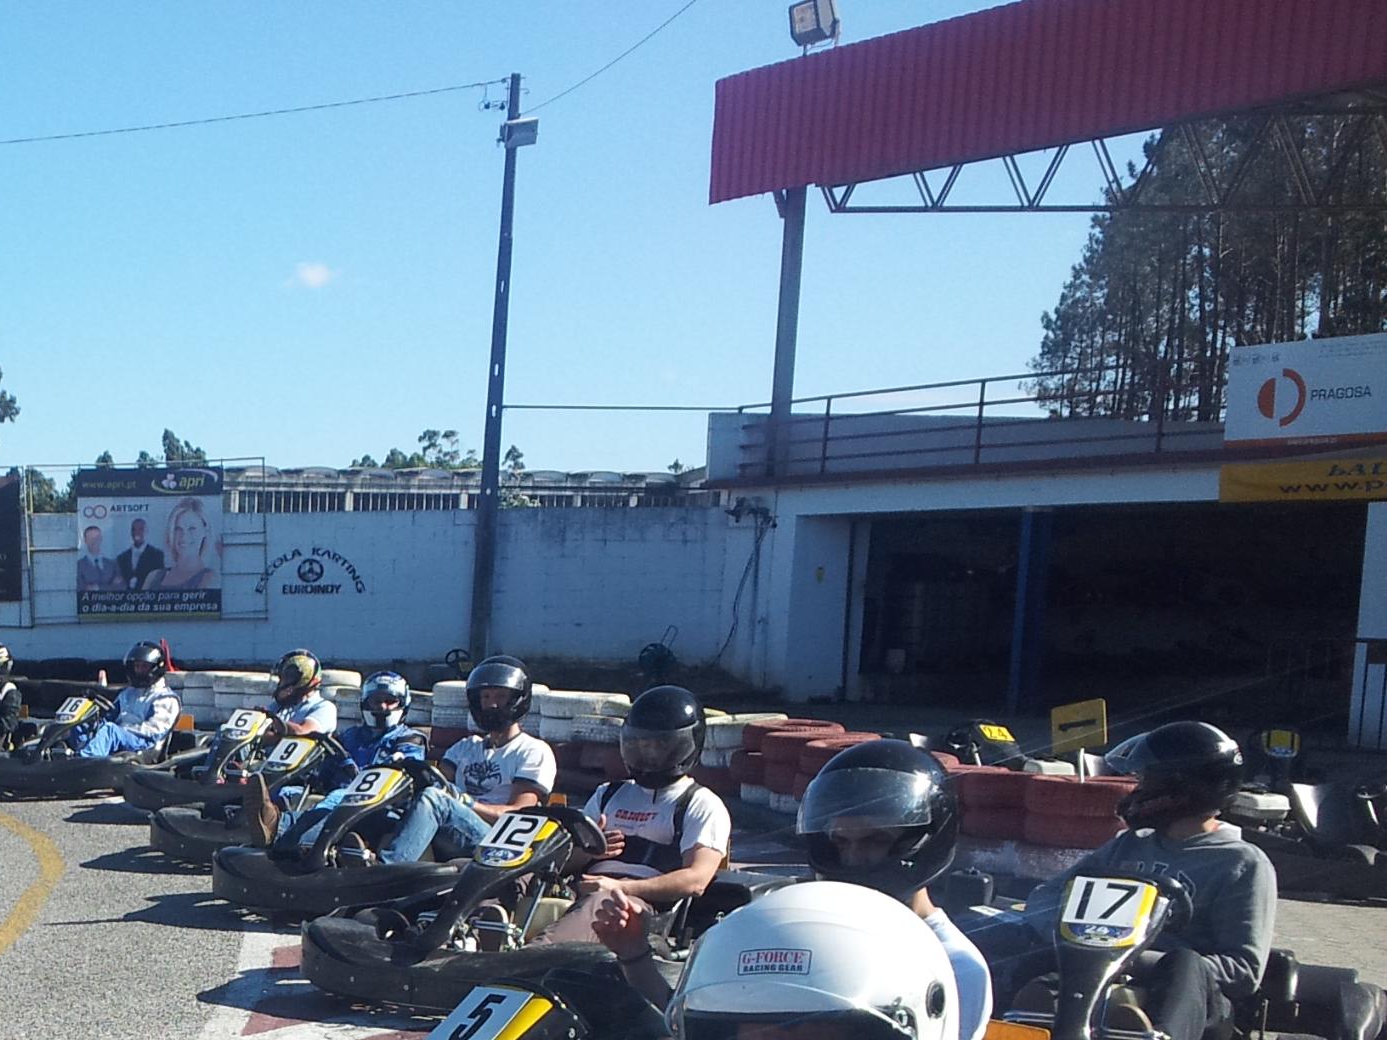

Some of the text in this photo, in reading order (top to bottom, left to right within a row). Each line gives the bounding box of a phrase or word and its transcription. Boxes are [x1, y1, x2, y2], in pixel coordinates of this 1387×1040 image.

[1310, 385, 1372, 401] PRAGOSA
[178, 474, 206, 490] apri
[1279, 480, 1387, 494] www.p
[110, 504, 149, 512] ARTSOFT
[312, 547, 366, 594] KARTING
[91, 592, 125, 600] melhor
[158, 592, 180, 602] para
[181, 591, 207, 602] gerir
[282, 584, 341, 594] EUROINDY
[91, 603, 135, 612] dia-a-dia
[137, 603, 150, 612] da
[173, 602, 218, 613] empresa
[60, 698, 83, 713] 16
[234, 712, 253, 727] 6
[983, 726, 1008, 739] 24
[279, 741, 298, 761] 9
[355, 771, 381, 792] 8
[490, 815, 539, 846] 12
[1075, 881, 1138, 920] 17
[742, 951, 805, 964] G-FORCE
[743, 964, 776, 972] RACING
